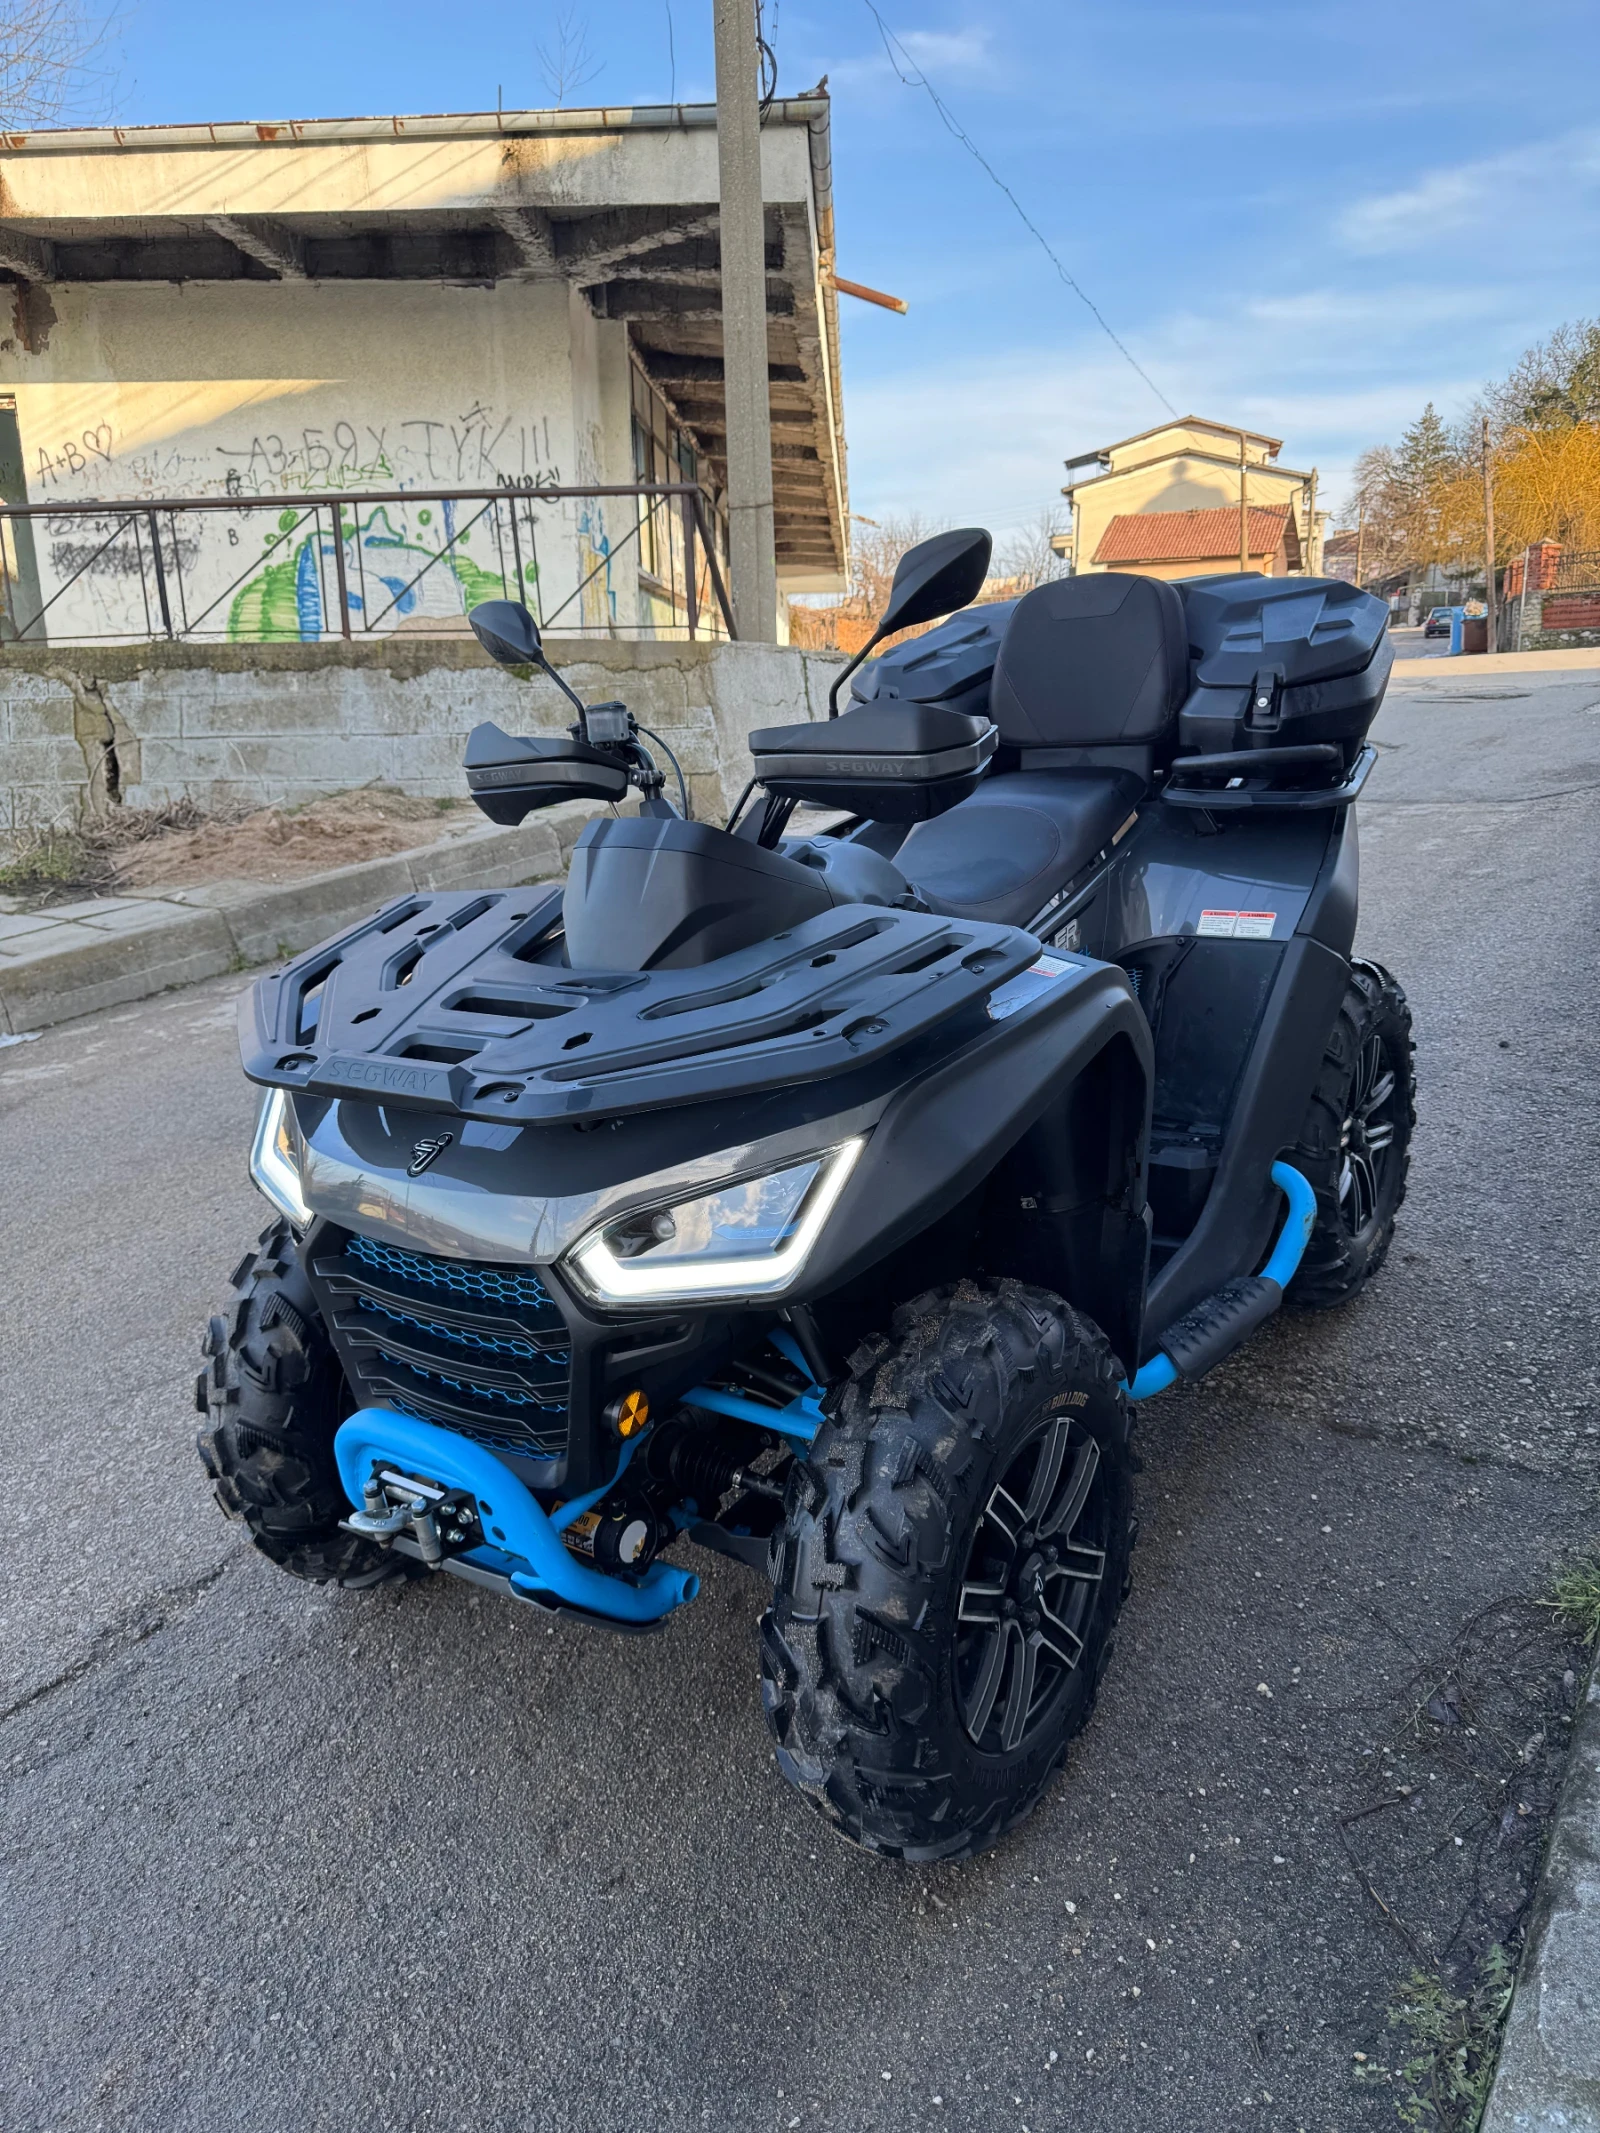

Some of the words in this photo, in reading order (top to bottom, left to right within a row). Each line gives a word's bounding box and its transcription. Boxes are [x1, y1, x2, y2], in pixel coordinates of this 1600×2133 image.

[825, 760, 905, 774] SEGWAY
[475, 768, 522, 784] SEGWAY
[329, 1060, 439, 1092] SEGWAY
[1050, 1391, 1090, 1410] BULLDOG
